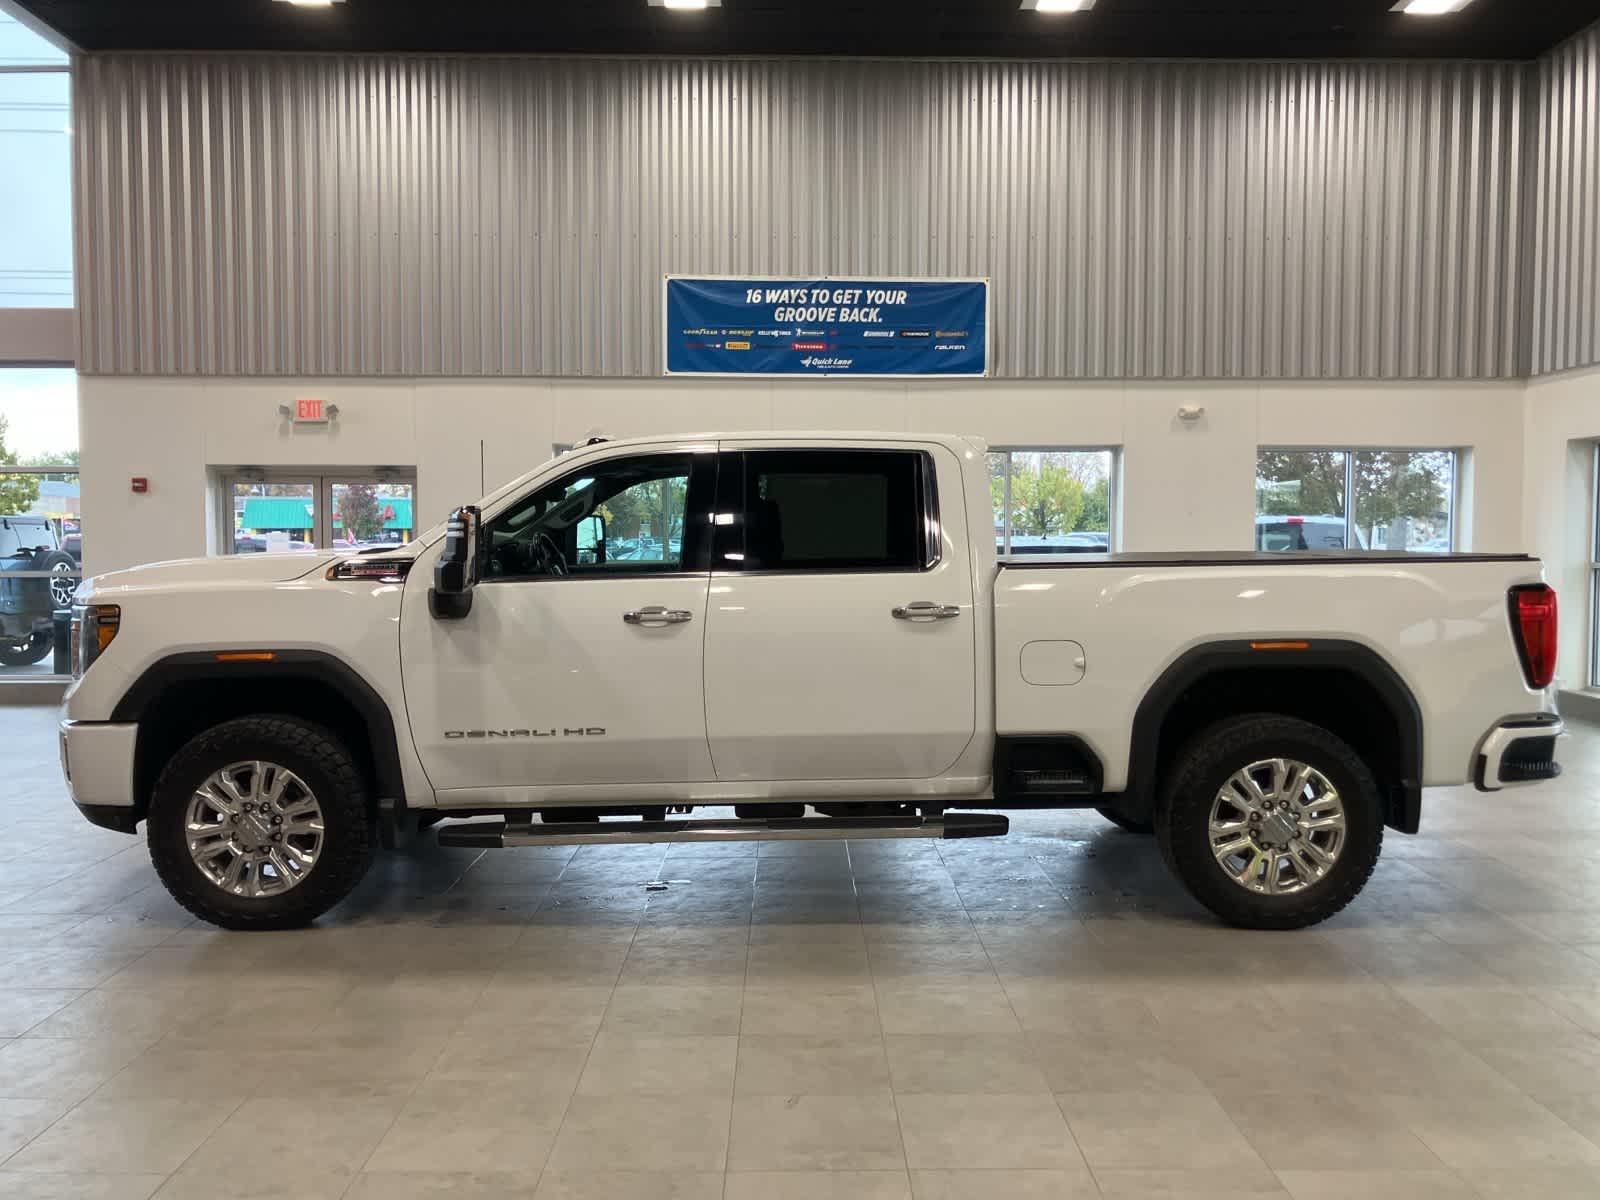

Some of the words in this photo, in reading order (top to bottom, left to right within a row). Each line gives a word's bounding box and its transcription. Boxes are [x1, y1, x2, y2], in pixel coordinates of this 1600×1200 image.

[746, 289, 762, 304] 16
[765, 289, 808, 304] WAYS
[811, 289, 830, 304] TO
[832, 289, 863, 305] GET
[866, 290, 908, 305] YOUR
[774, 307, 838, 322] GROOVE
[839, 307, 883, 322] BACK.
[811, 357, 833, 366] Quick
[833, 358, 853, 366] Lane
[296, 399, 321, 417] EXIT
[444, 729, 556, 738] DENALI
[563, 727, 606, 736] HD
